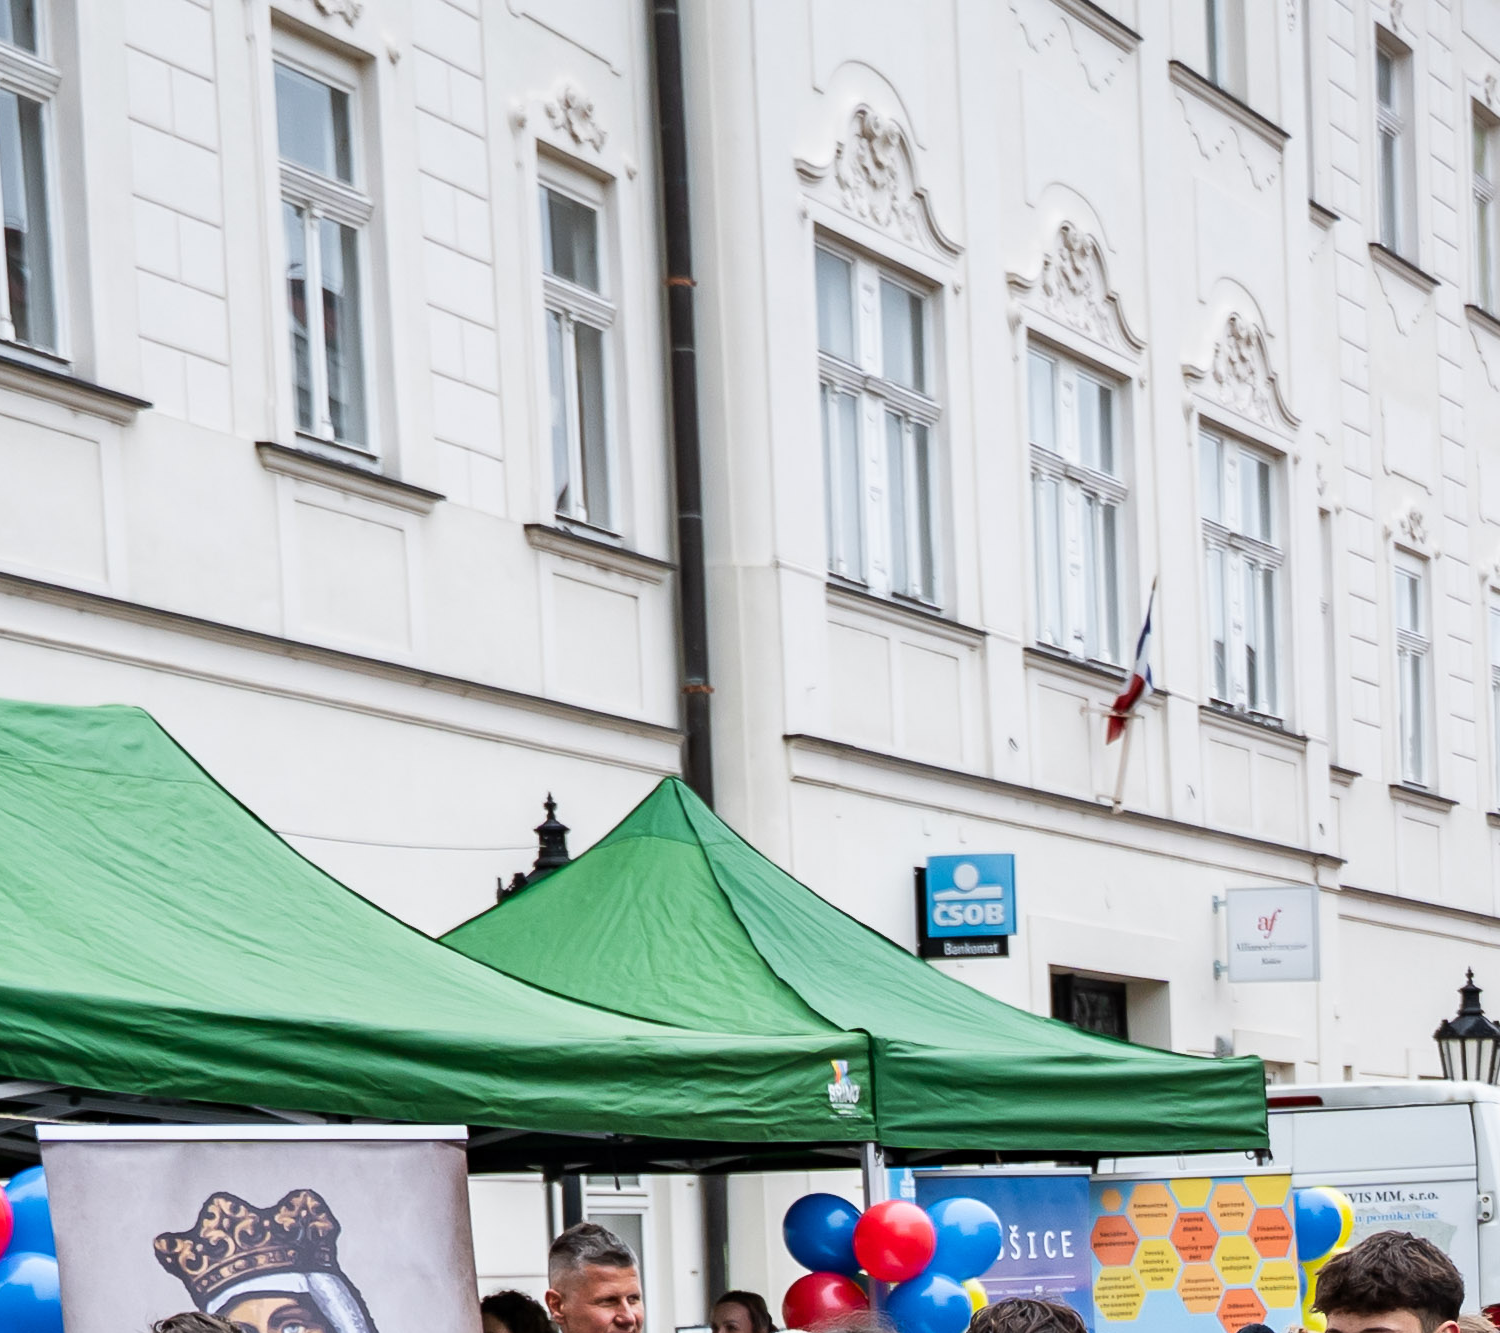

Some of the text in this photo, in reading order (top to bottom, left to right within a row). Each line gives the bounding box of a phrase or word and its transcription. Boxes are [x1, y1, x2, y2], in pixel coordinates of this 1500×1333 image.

[933, 902, 1005, 928] ČSOB
[943, 942, 999, 956] Bankomat
[1344, 1190, 1439, 1204] VIS MM, s.r.o.
[997, 1224, 1075, 1262] ŠICE
